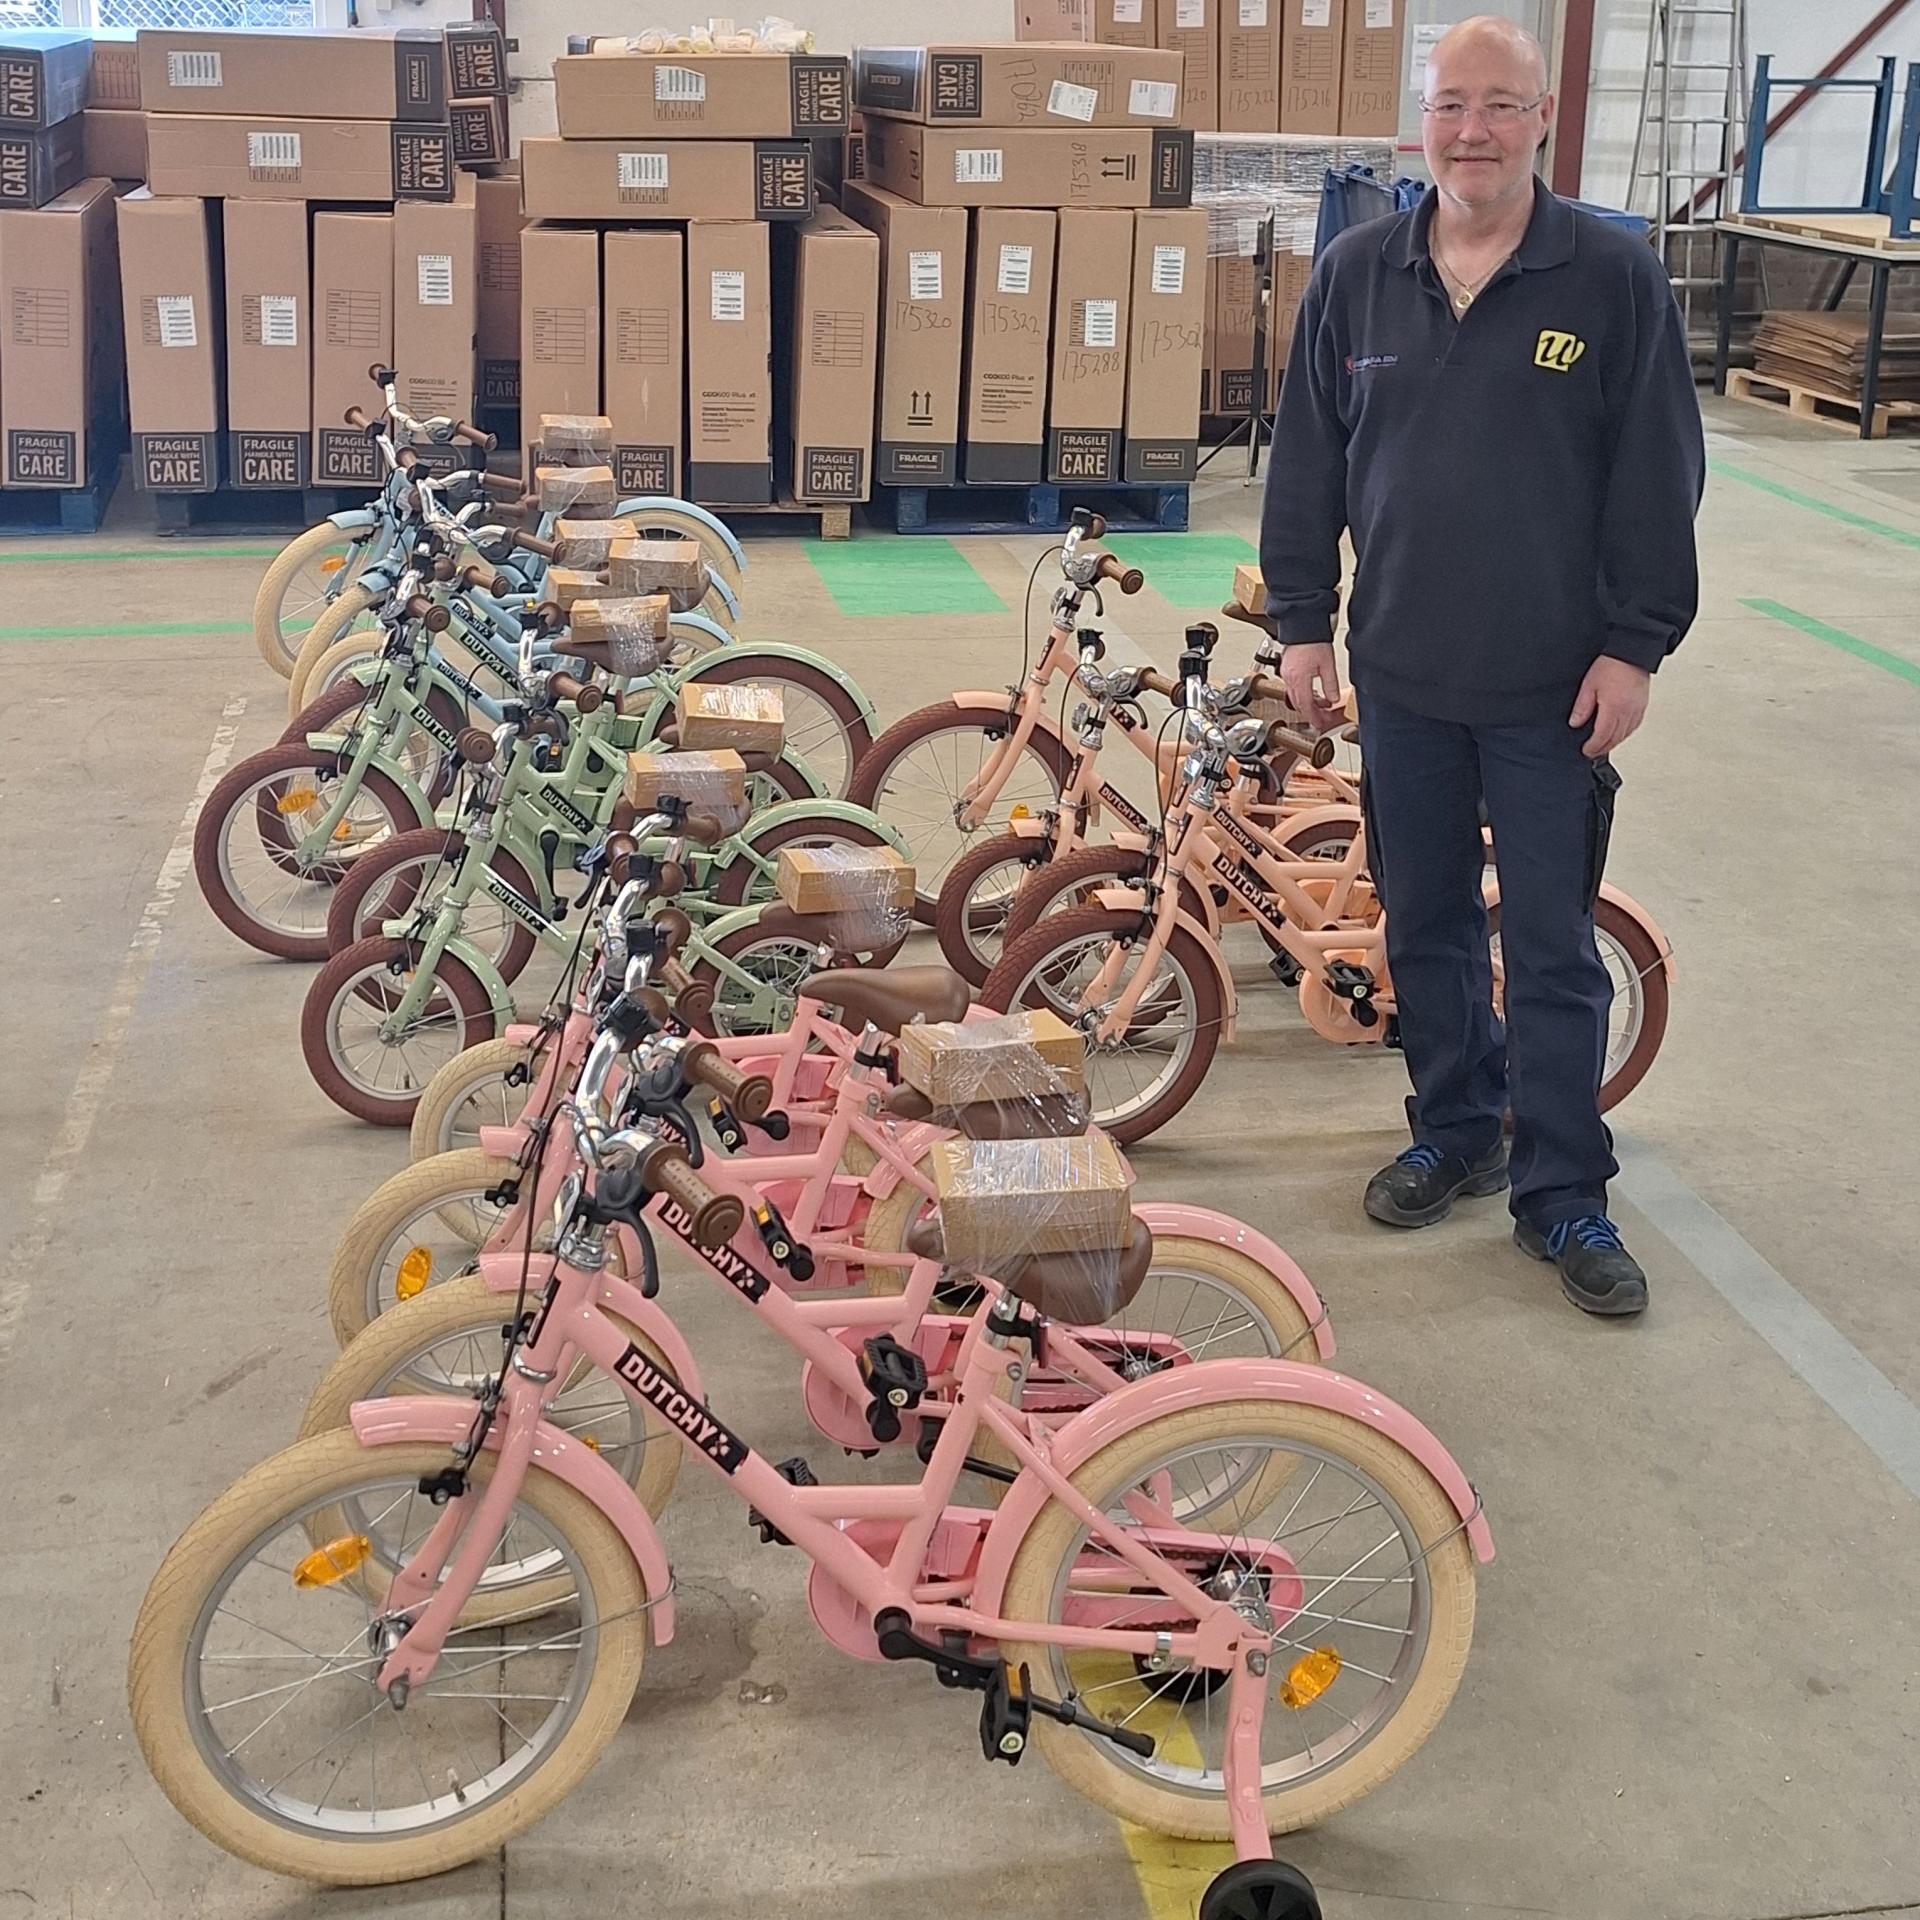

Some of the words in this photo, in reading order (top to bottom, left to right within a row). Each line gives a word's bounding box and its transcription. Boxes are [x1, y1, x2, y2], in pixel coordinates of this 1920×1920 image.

[410, 60, 419, 98] FRAGILE
[454, 45, 470, 88] FRAGILE
[473, 43, 496, 87] CARE
[9, 64, 34, 117] CARE
[799, 71, 810, 121] FRAGILE
[819, 71, 842, 122] CARE
[938, 64, 958, 108] CARE
[966, 64, 975, 108] FRAGILE
[468, 113, 488, 151] CARE
[2, 143, 27, 196] CARE
[401, 138, 413, 188] FRAGILE
[421, 138, 445, 188] CARE
[1070, 142, 1090, 198] 175318
[1162, 147, 1172, 188] FRAGILE
[763, 158, 774, 207] FRAGILE
[783, 158, 805, 207] CARE
[895, 301, 952, 331] 175320
[983, 300, 1040, 335] 175322
[1062, 351, 1120, 384] 175288
[1228, 389, 1251, 405] CAR
[19, 437, 65, 448] FRAGILE
[148, 440, 199, 451] FRAGILE
[244, 439, 294, 450] FRAGILE
[328, 436, 373, 447] FRAGILE
[622, 452, 665, 462] FRAGILE
[812, 454, 854, 464] FRAGILE
[899, 454, 938, 463] FRAGILE
[1063, 436, 1107, 446] FRAGILE
[1146, 452, 1179, 460] FRAGILE
[19, 455, 66, 476] CARE
[150, 460, 201, 483] CARE
[244, 459, 296, 481] CARE
[328, 453, 373, 474] CARE
[622, 469, 665, 489] CARE
[811, 472, 854, 491] CARE
[1061, 453, 1107, 475] CARE
[414, 707, 456, 749] DUTCH
[542, 788, 581, 827] DUTCHY
[1101, 786, 1137, 822] DUTCHY
[1215, 810, 1252, 851] DUTCHY
[492, 882, 535, 922] DUTCHY
[1217, 858, 1271, 914] DUTCHY
[663, 1203, 742, 1280] DUHY
[620, 1352, 709, 1443] DUTCHY
